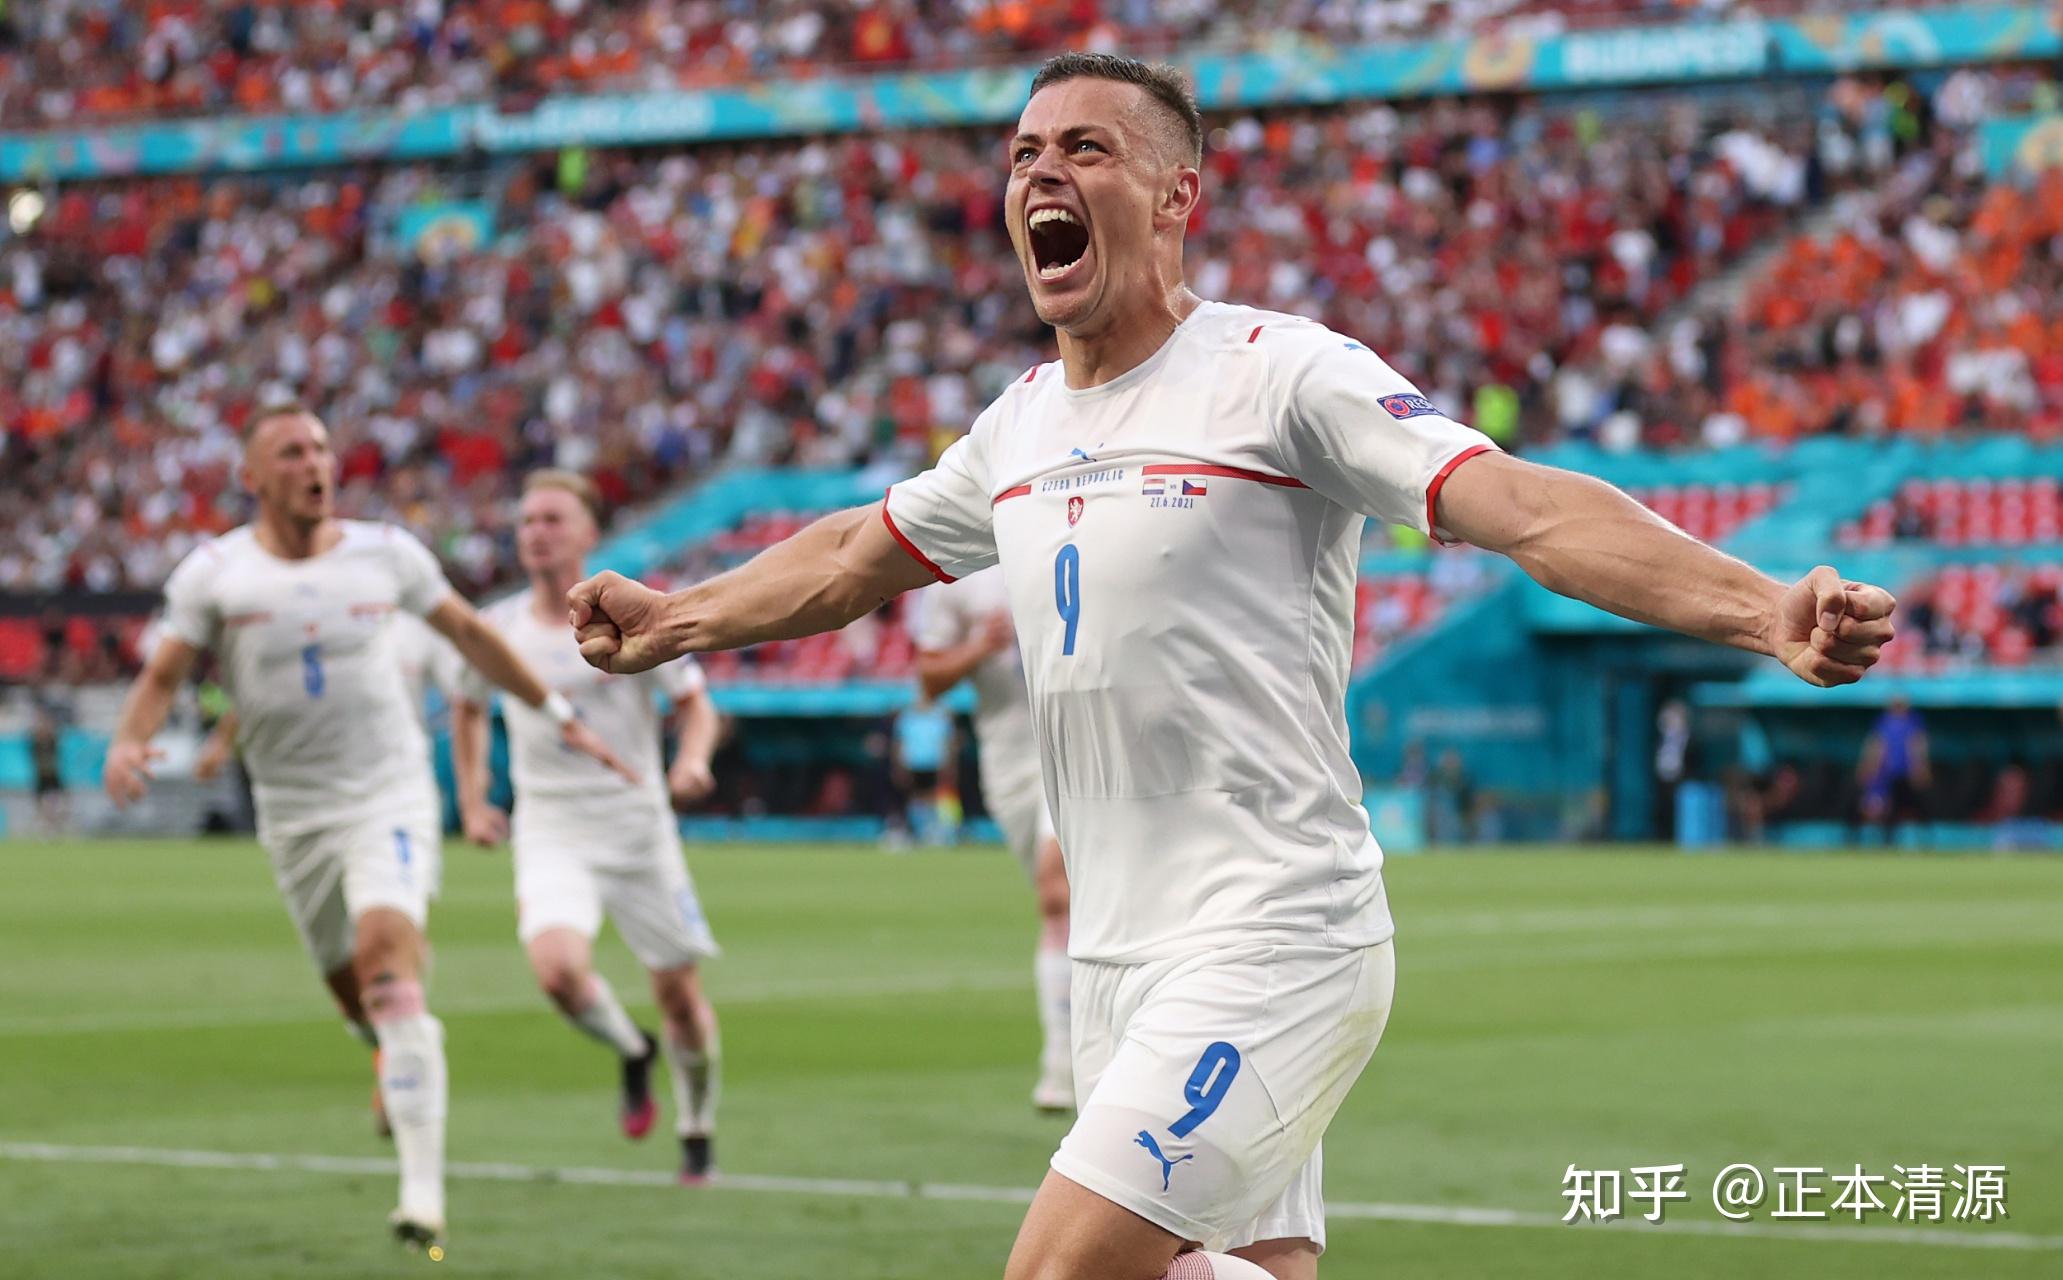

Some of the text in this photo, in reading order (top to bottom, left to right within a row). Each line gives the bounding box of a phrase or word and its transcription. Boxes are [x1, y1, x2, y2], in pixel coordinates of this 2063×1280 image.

[1042, 470, 1123, 492] CZECH REPUBLIC
[1150, 497, 1194, 509] 27.6.2021
[1055, 543, 1081, 657] 9
[1167, 1041, 1241, 1139] 9
